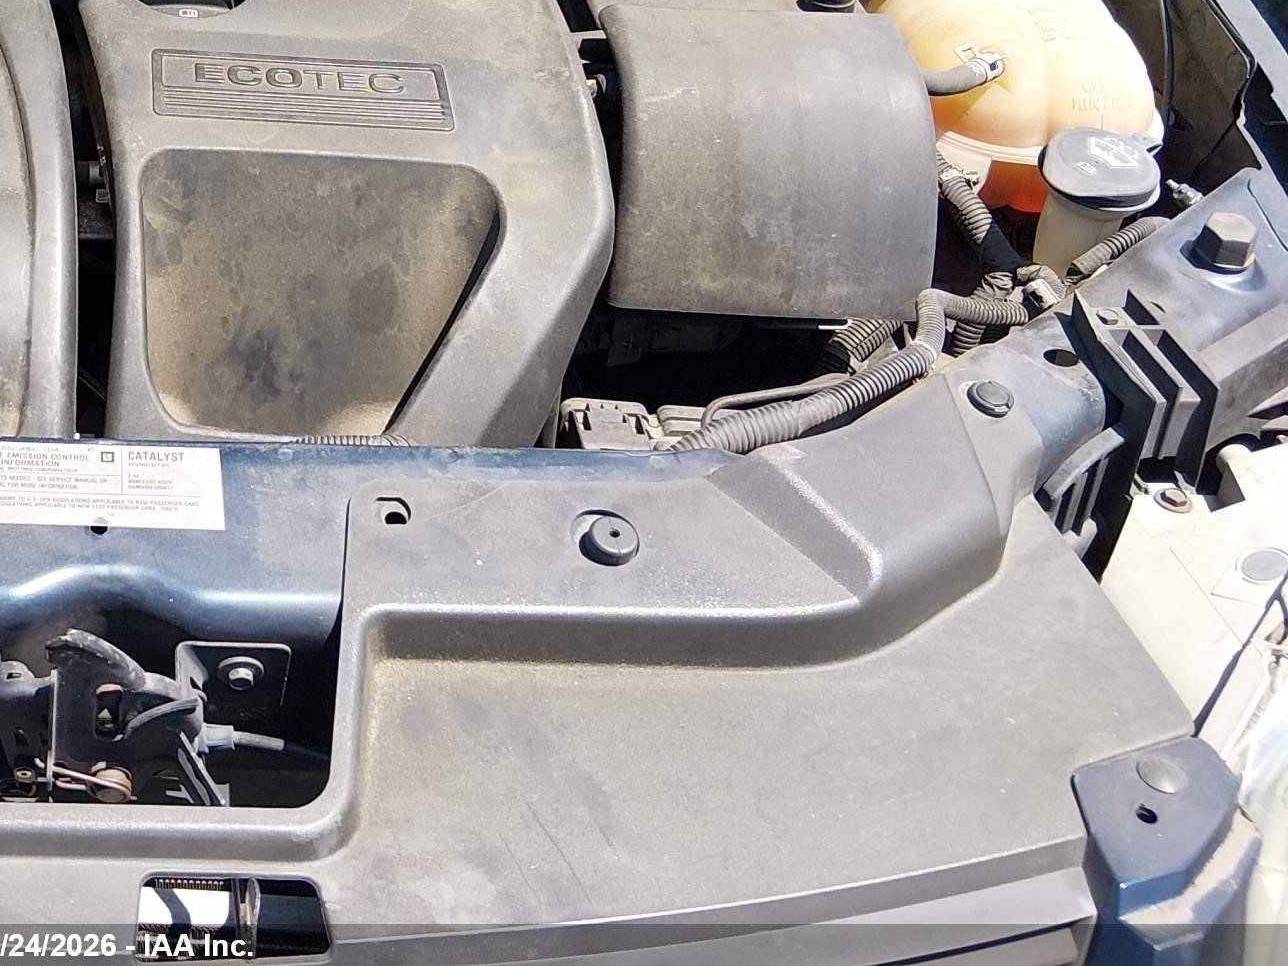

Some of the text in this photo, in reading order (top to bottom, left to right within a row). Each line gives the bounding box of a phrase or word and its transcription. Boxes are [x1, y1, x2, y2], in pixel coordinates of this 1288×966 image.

[194, 62, 405, 94] ECOTEC
[7, 452, 48, 460] EMISSION
[50, 454, 89, 462] CONTROL
[128, 451, 184, 462] CATALYST
[0, 459, 60, 467] INFORMATION
